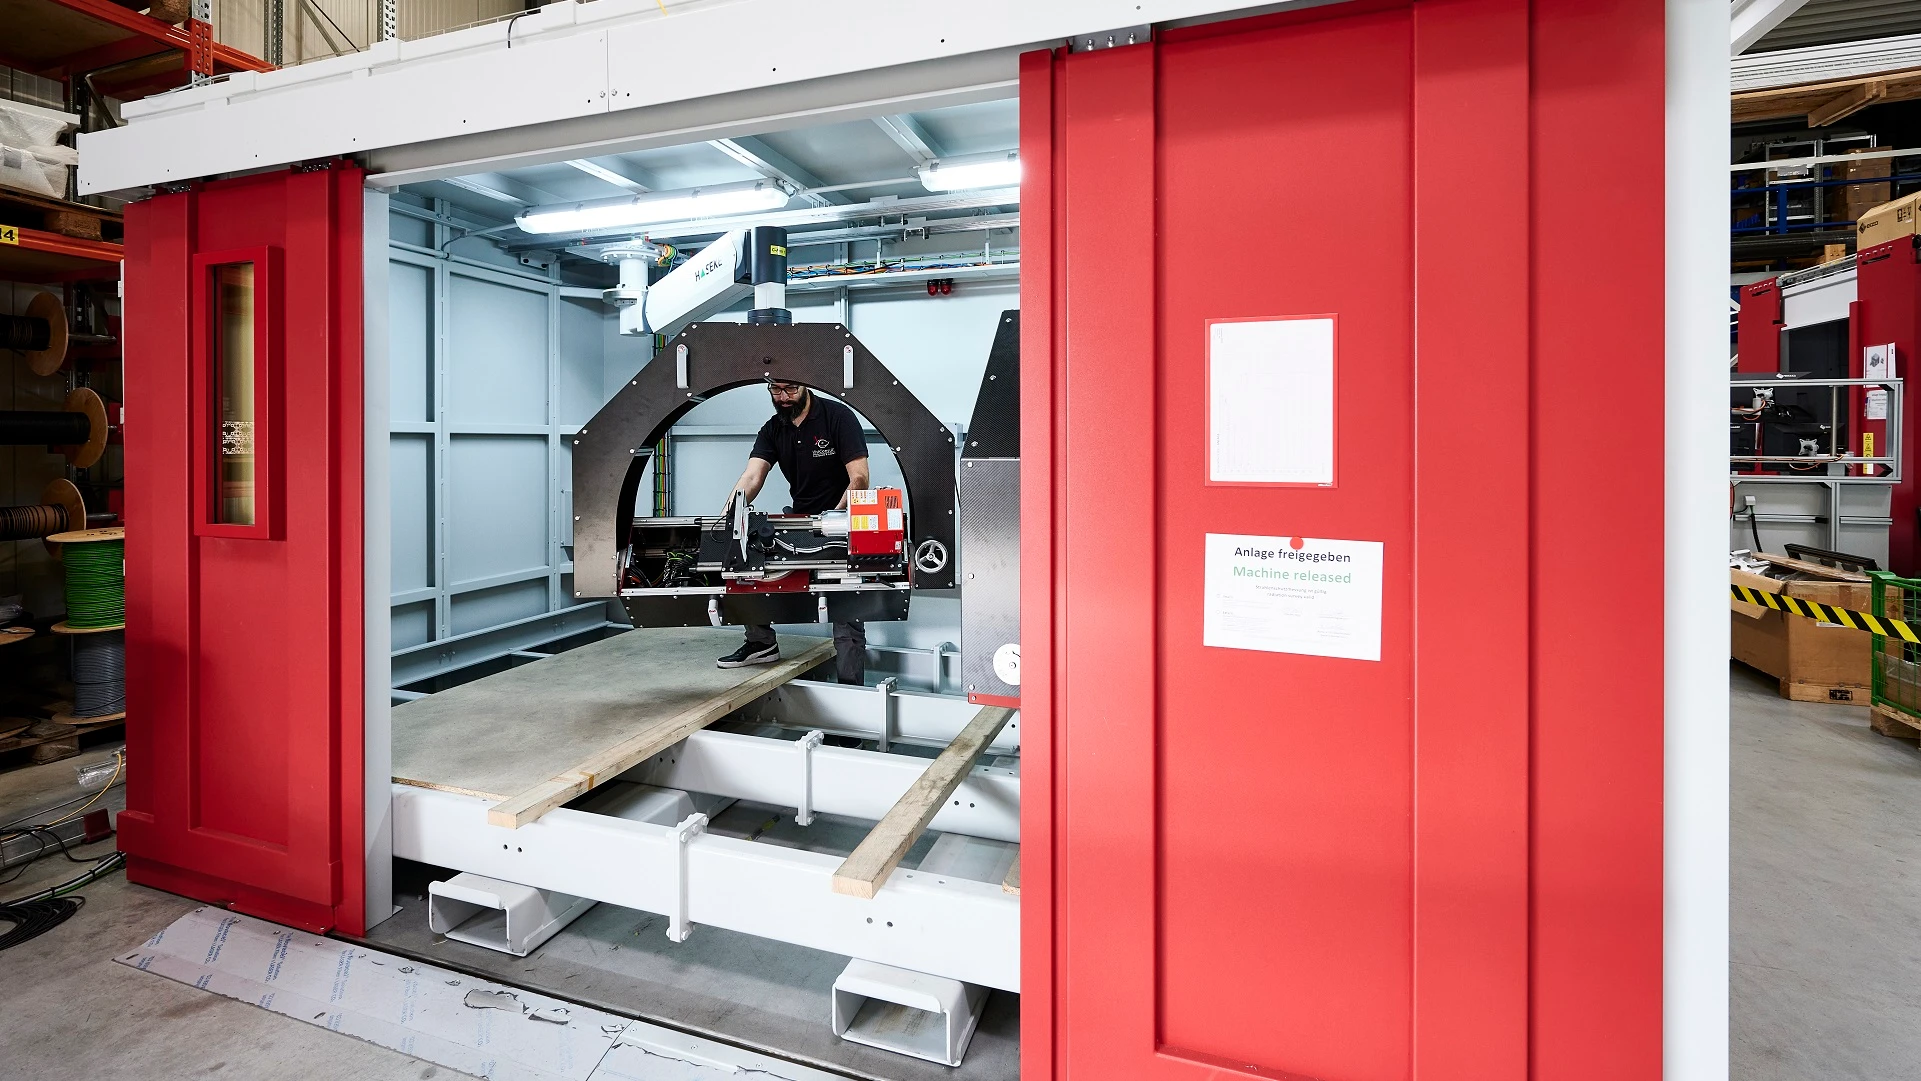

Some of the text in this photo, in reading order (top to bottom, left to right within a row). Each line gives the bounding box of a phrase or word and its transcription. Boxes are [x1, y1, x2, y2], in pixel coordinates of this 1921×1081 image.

[1234, 547, 1351, 563] Anlage freigegeben
[1233, 566, 1351, 584] Machine released
